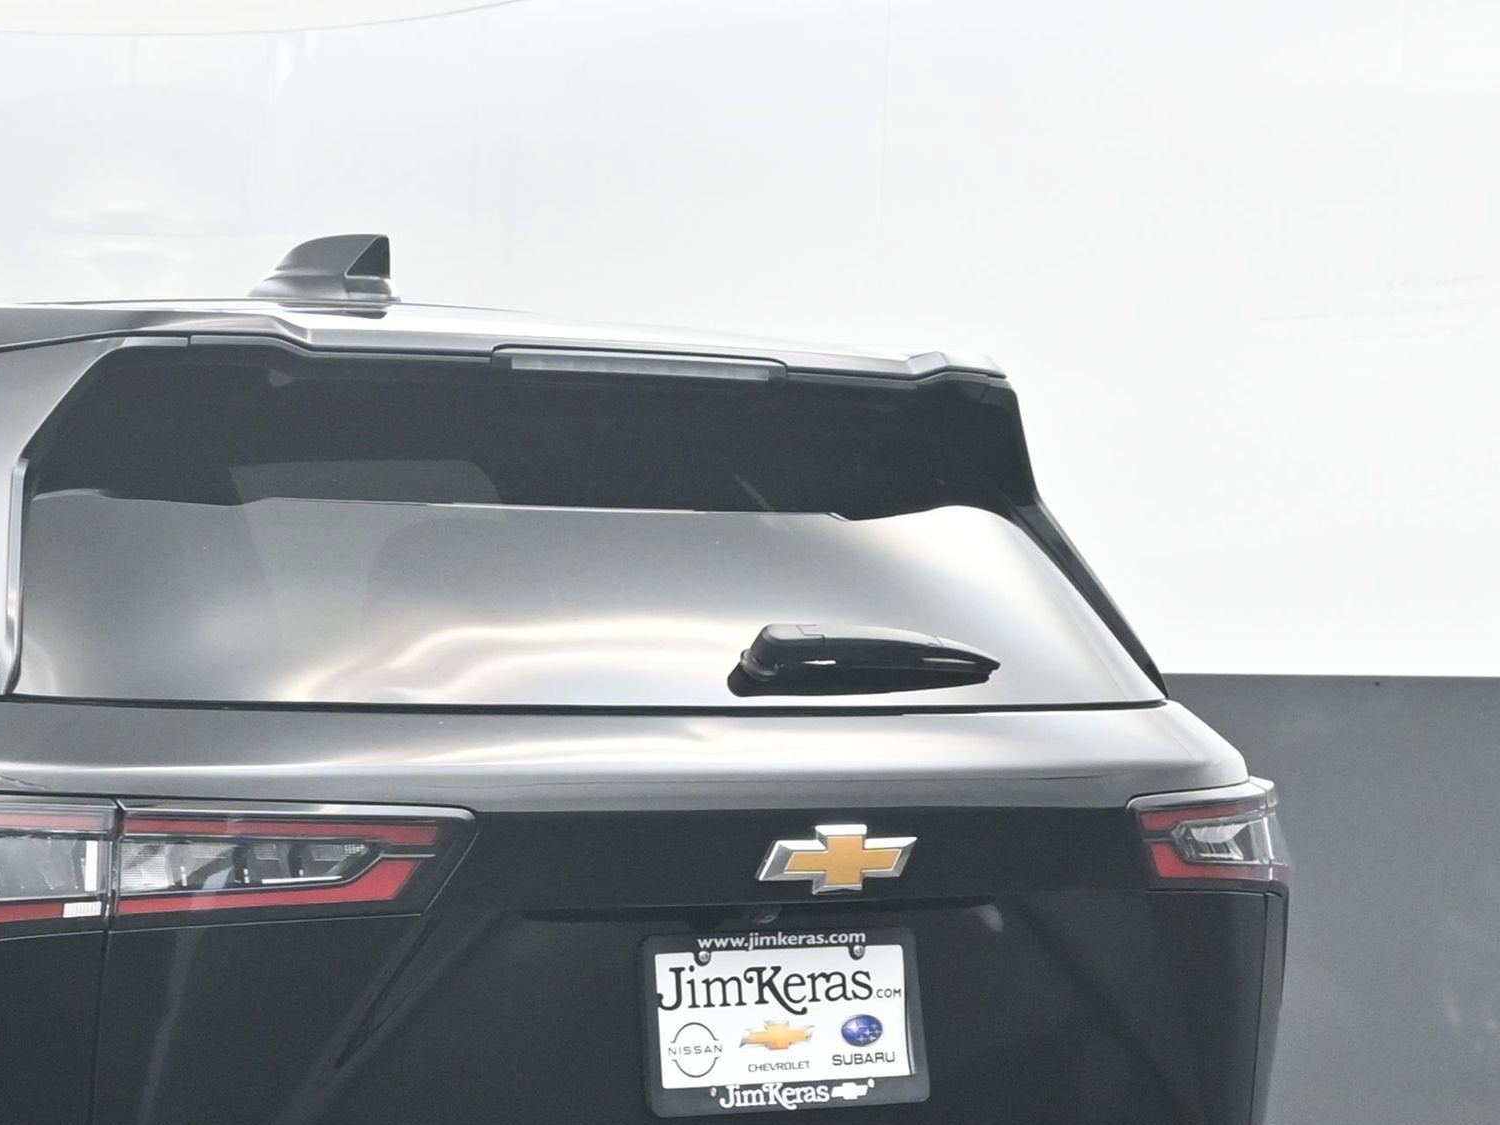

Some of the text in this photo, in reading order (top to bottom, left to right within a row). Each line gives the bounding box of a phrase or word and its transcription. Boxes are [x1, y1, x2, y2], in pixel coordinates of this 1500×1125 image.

[697, 931, 866, 950] www.jimkeras.com
[668, 1044, 723, 1056] NISSAN
[832, 1051, 895, 1067] SUBARU
[748, 1060, 810, 1073] CHEVROLET
